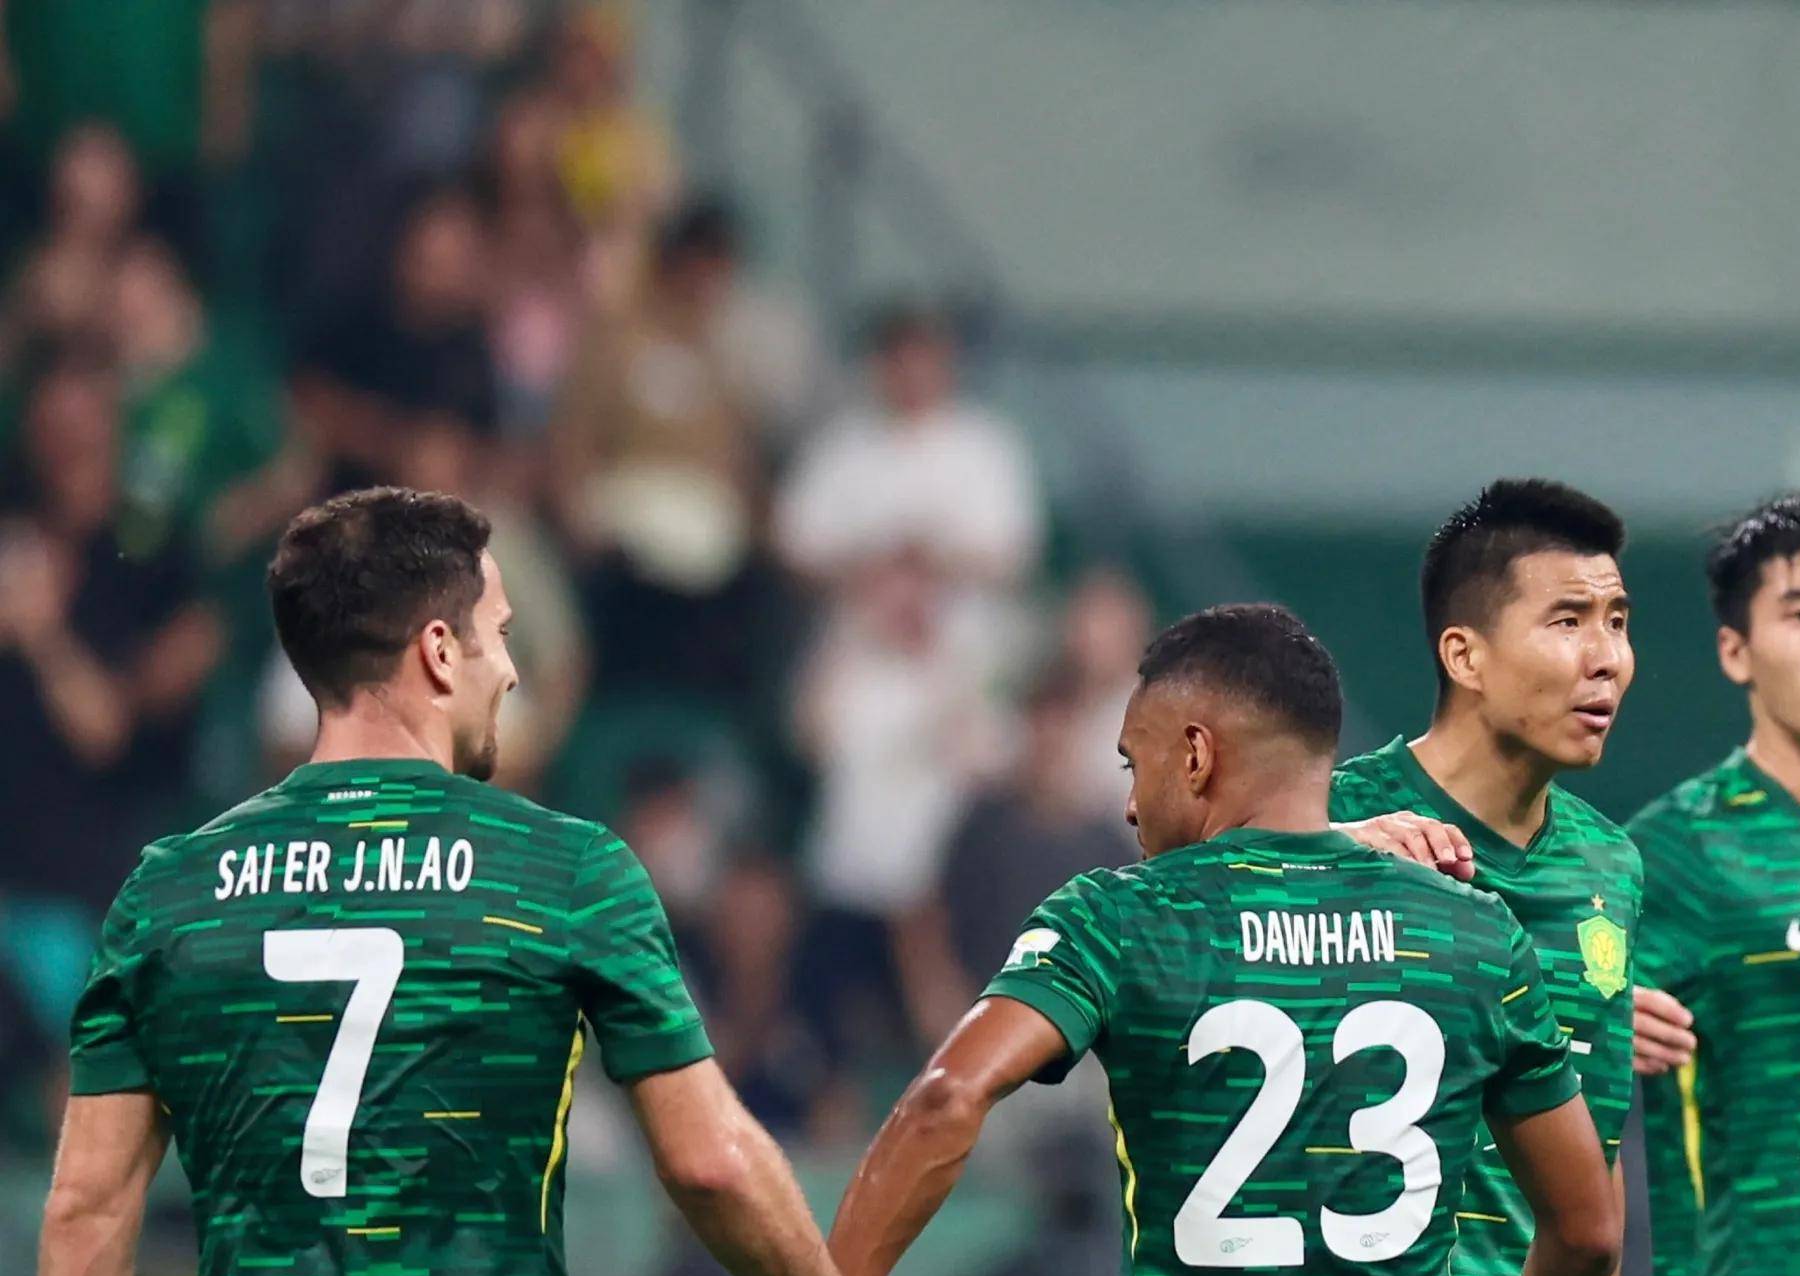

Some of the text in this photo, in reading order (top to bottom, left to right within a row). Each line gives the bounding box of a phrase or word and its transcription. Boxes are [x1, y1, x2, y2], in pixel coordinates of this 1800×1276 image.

[263, 927, 404, 1197] 7
[1240, 909, 1395, 966] DAWHAN
[1173, 999, 1446, 1267] 23
